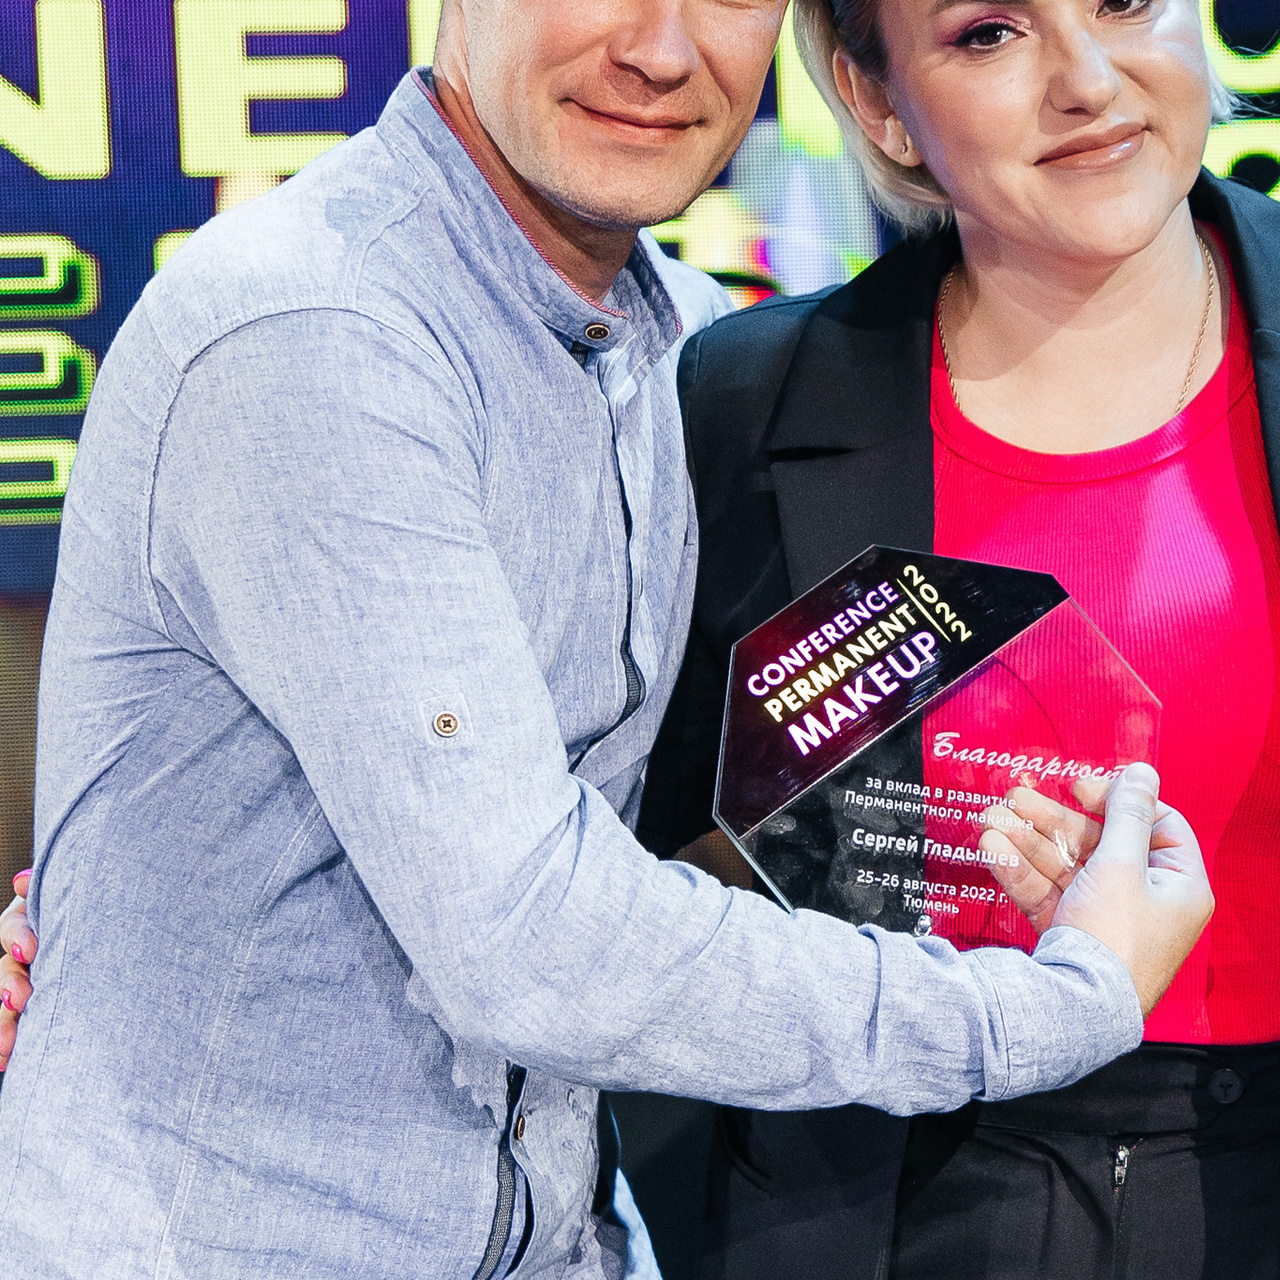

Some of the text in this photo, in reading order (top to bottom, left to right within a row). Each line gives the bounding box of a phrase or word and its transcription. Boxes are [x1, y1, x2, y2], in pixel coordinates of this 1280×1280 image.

[903, 564, 973, 642] 2022
[747, 581, 899, 696] CONFERENCE
[763, 603, 917, 722] PERMANENT
[786, 631, 936, 756] MAKEUP
[933, 732, 1127, 780] Благодарност
[845, 790, 1034, 830] Перманентного макияжа
[865, 777, 1016, 810] за вклад в развитие
[852, 828, 1020, 868] Сергей Гладышев
[856, 869, 900, 888] 25-26
[903, 878, 957, 896] августа
[960, 884, 996, 902] 2022
[903, 893, 960, 914] Тюмень
